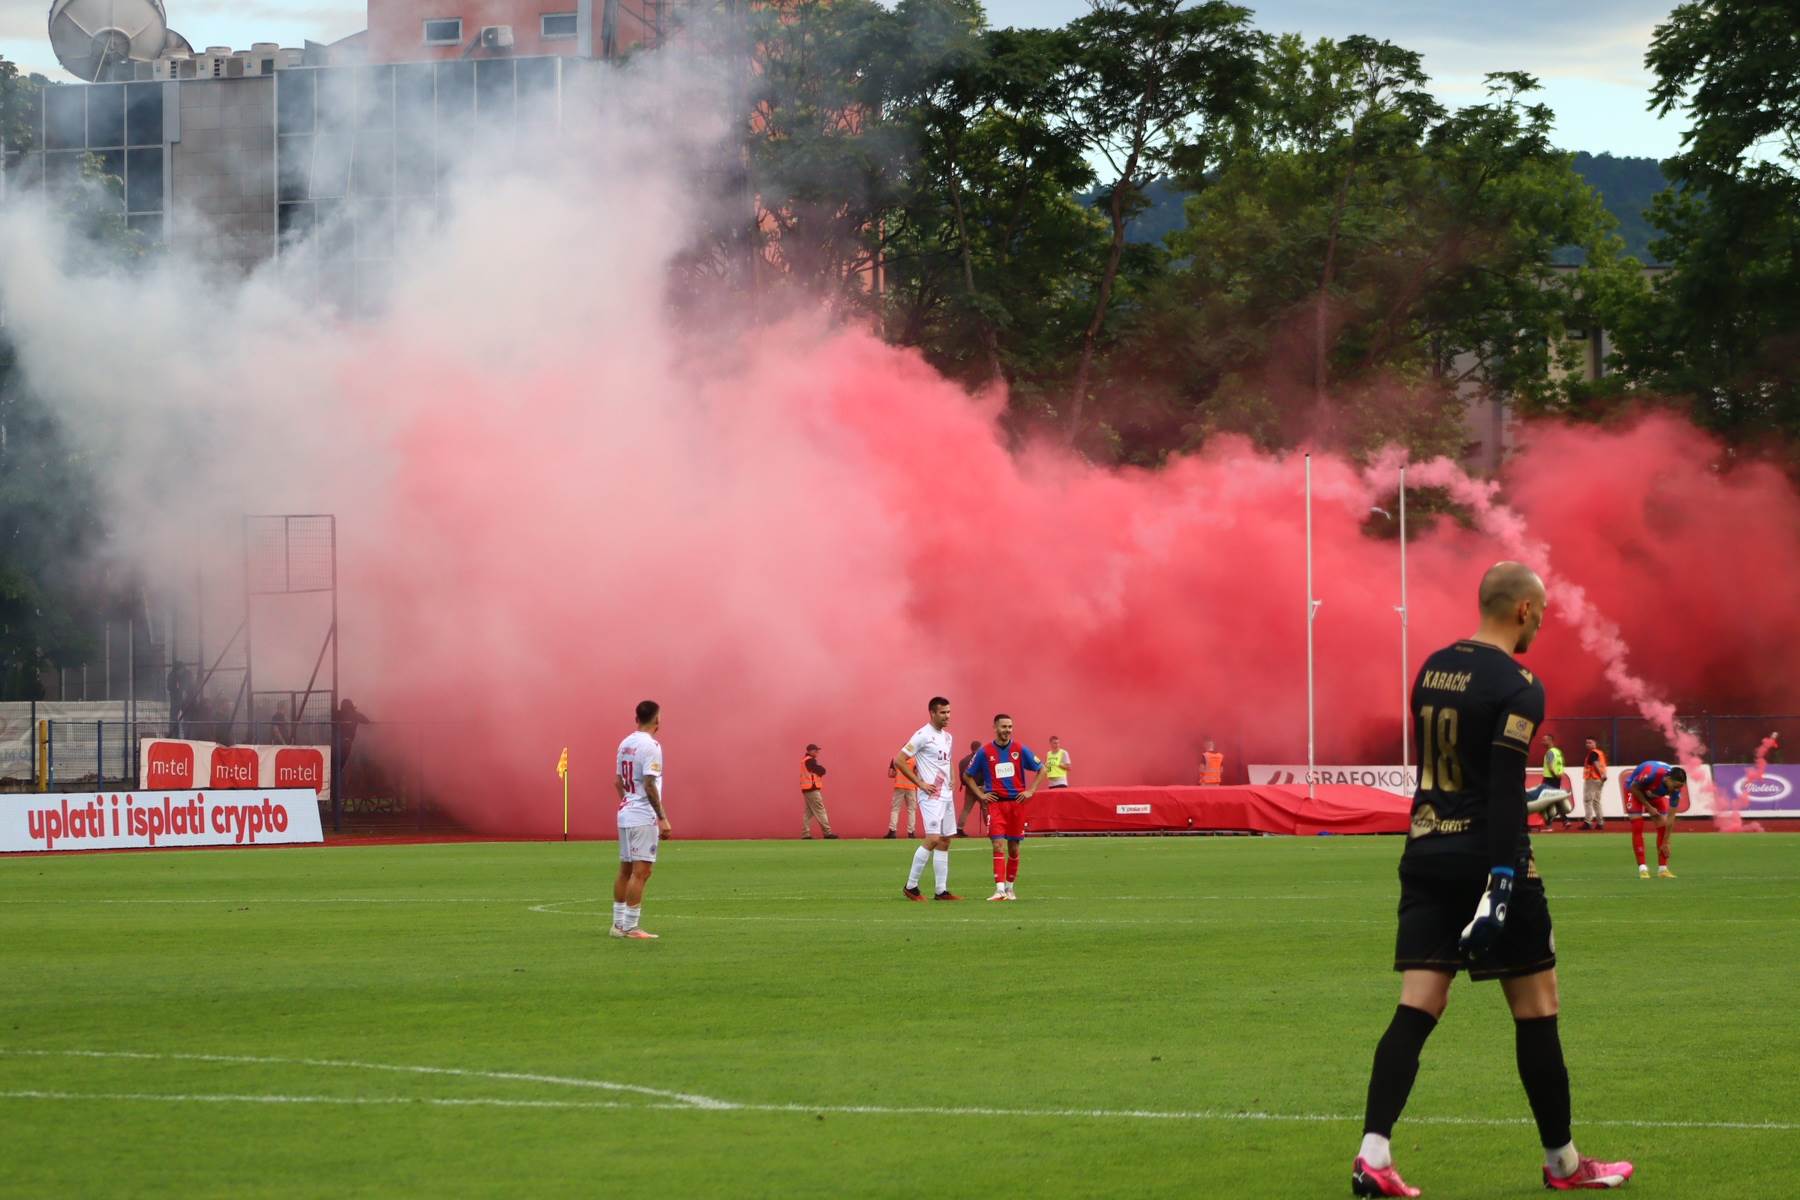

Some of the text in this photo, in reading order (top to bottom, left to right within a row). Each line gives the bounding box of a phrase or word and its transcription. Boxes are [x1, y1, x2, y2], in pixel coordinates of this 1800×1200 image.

[1422, 670, 1471, 691] KARAČIĆ
[1421, 706, 1462, 791] 18
[152, 757, 189, 777] m:tel
[216, 761, 252, 781] m:tel
[280, 763, 317, 782] m:tel
[621, 761, 635, 794] 91
[1744, 782, 1781, 793] Violeta
[28, 793, 289, 848] uplati i isplati crypto
